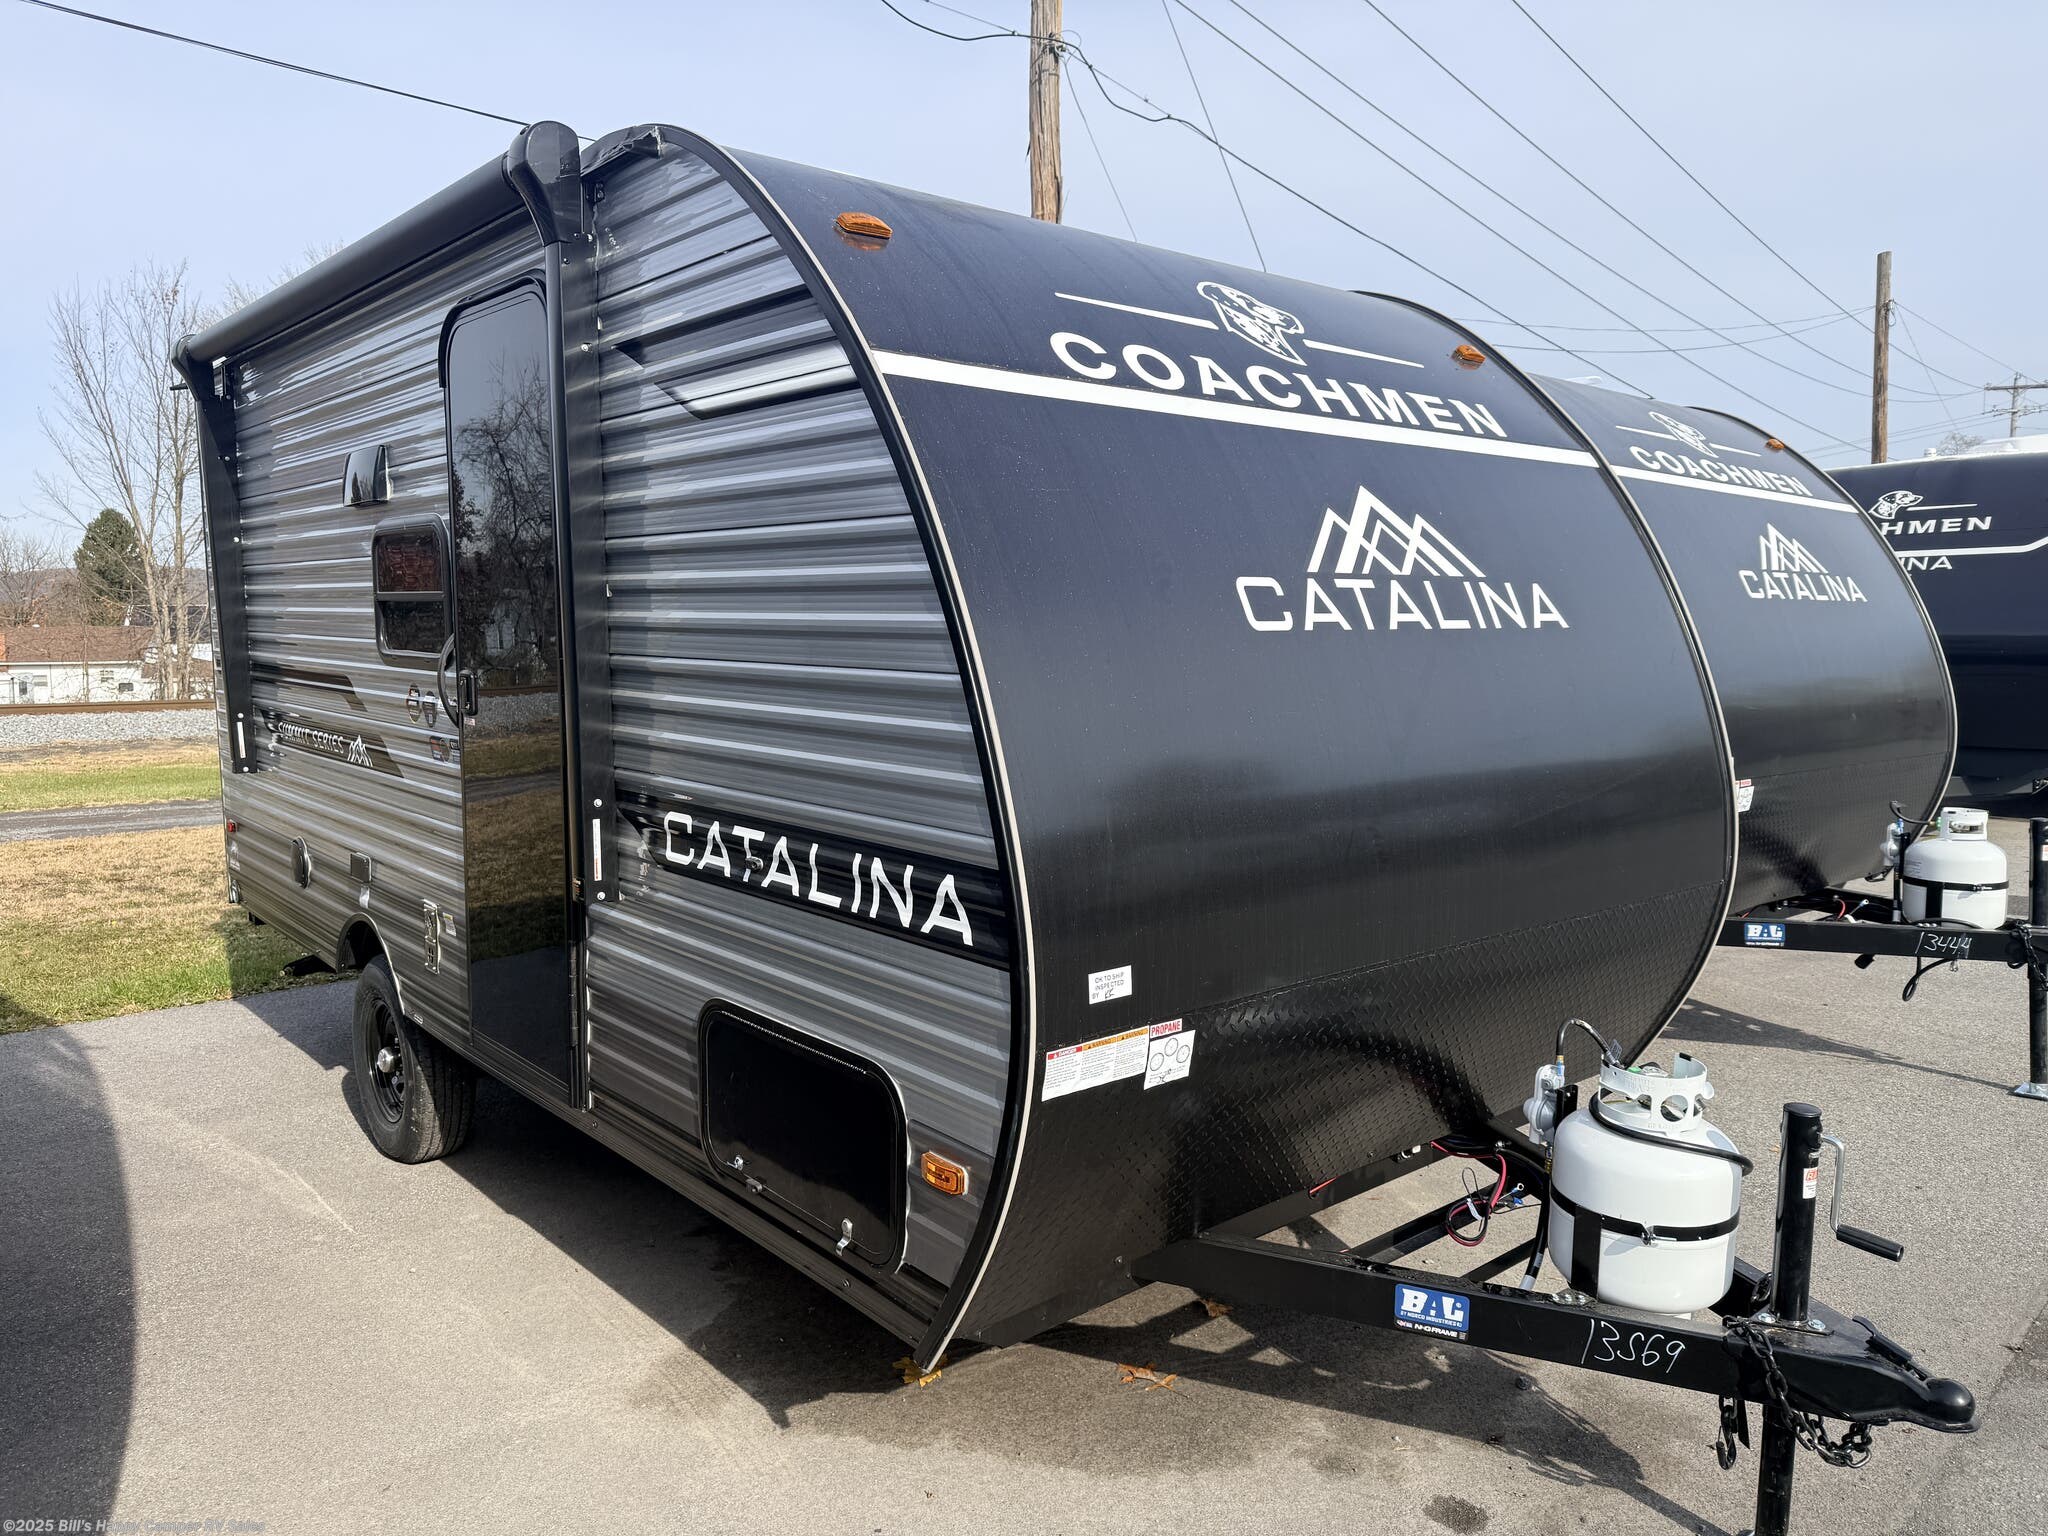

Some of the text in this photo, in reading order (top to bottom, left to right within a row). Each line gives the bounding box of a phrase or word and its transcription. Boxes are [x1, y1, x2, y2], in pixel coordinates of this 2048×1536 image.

[1050, 332, 1507, 437] COACHMEN
[1629, 446, 1813, 497] COACHMEN
[1738, 570, 1868, 602] CATALINA
[1235, 576, 1570, 631] CATALINA
[312, 730, 344, 754] SERIES
[664, 811, 973, 946] CATALINA
[1915, 932, 1973, 959] 13444
[1095, 980, 1124, 991] INSPECTED
[1112, 972, 1124, 980] SHIP
[1151, 1020, 1181, 1036] PROPANE
